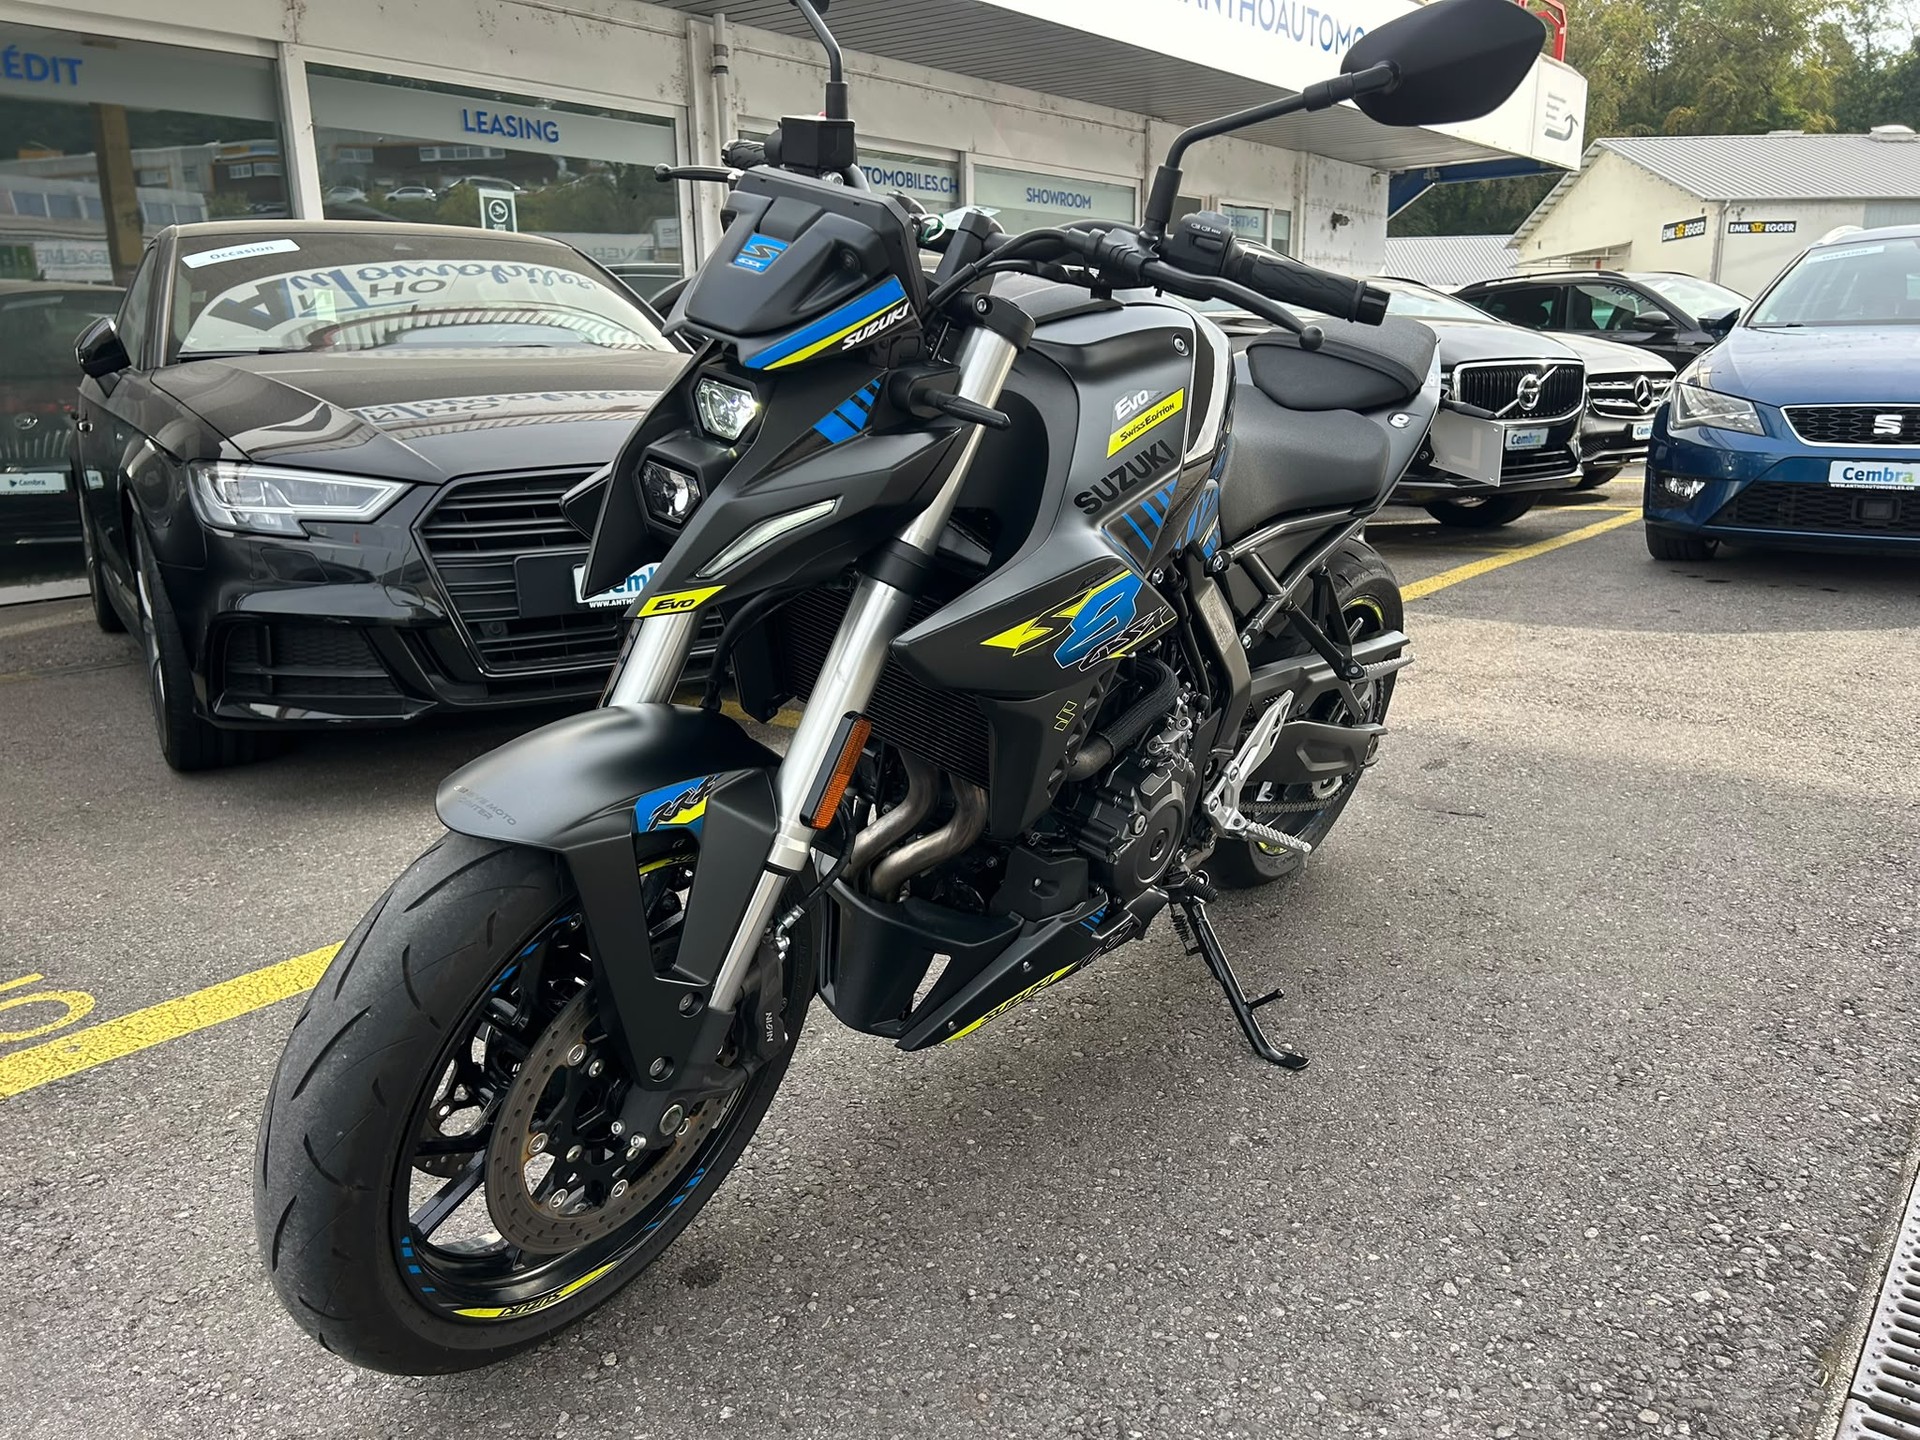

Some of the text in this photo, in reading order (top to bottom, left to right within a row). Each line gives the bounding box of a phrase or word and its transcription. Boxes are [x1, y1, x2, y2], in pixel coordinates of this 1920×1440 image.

[0, 44, 83, 86] ÉDIT
[463, 109, 559, 143] LEASING
[1026, 187, 1091, 209] SHOWROOM
[1663, 221, 1705, 240] EMIL EGGER
[1729, 223, 1795, 232] EMIL EGGER
[210, 244, 275, 260] Occasion
[842, 302, 910, 350] SUZUKI
[1511, 432, 1541, 445] Cembra
[1073, 439, 1176, 515] SUZUKI
[1842, 467, 1915, 483] Cembra
